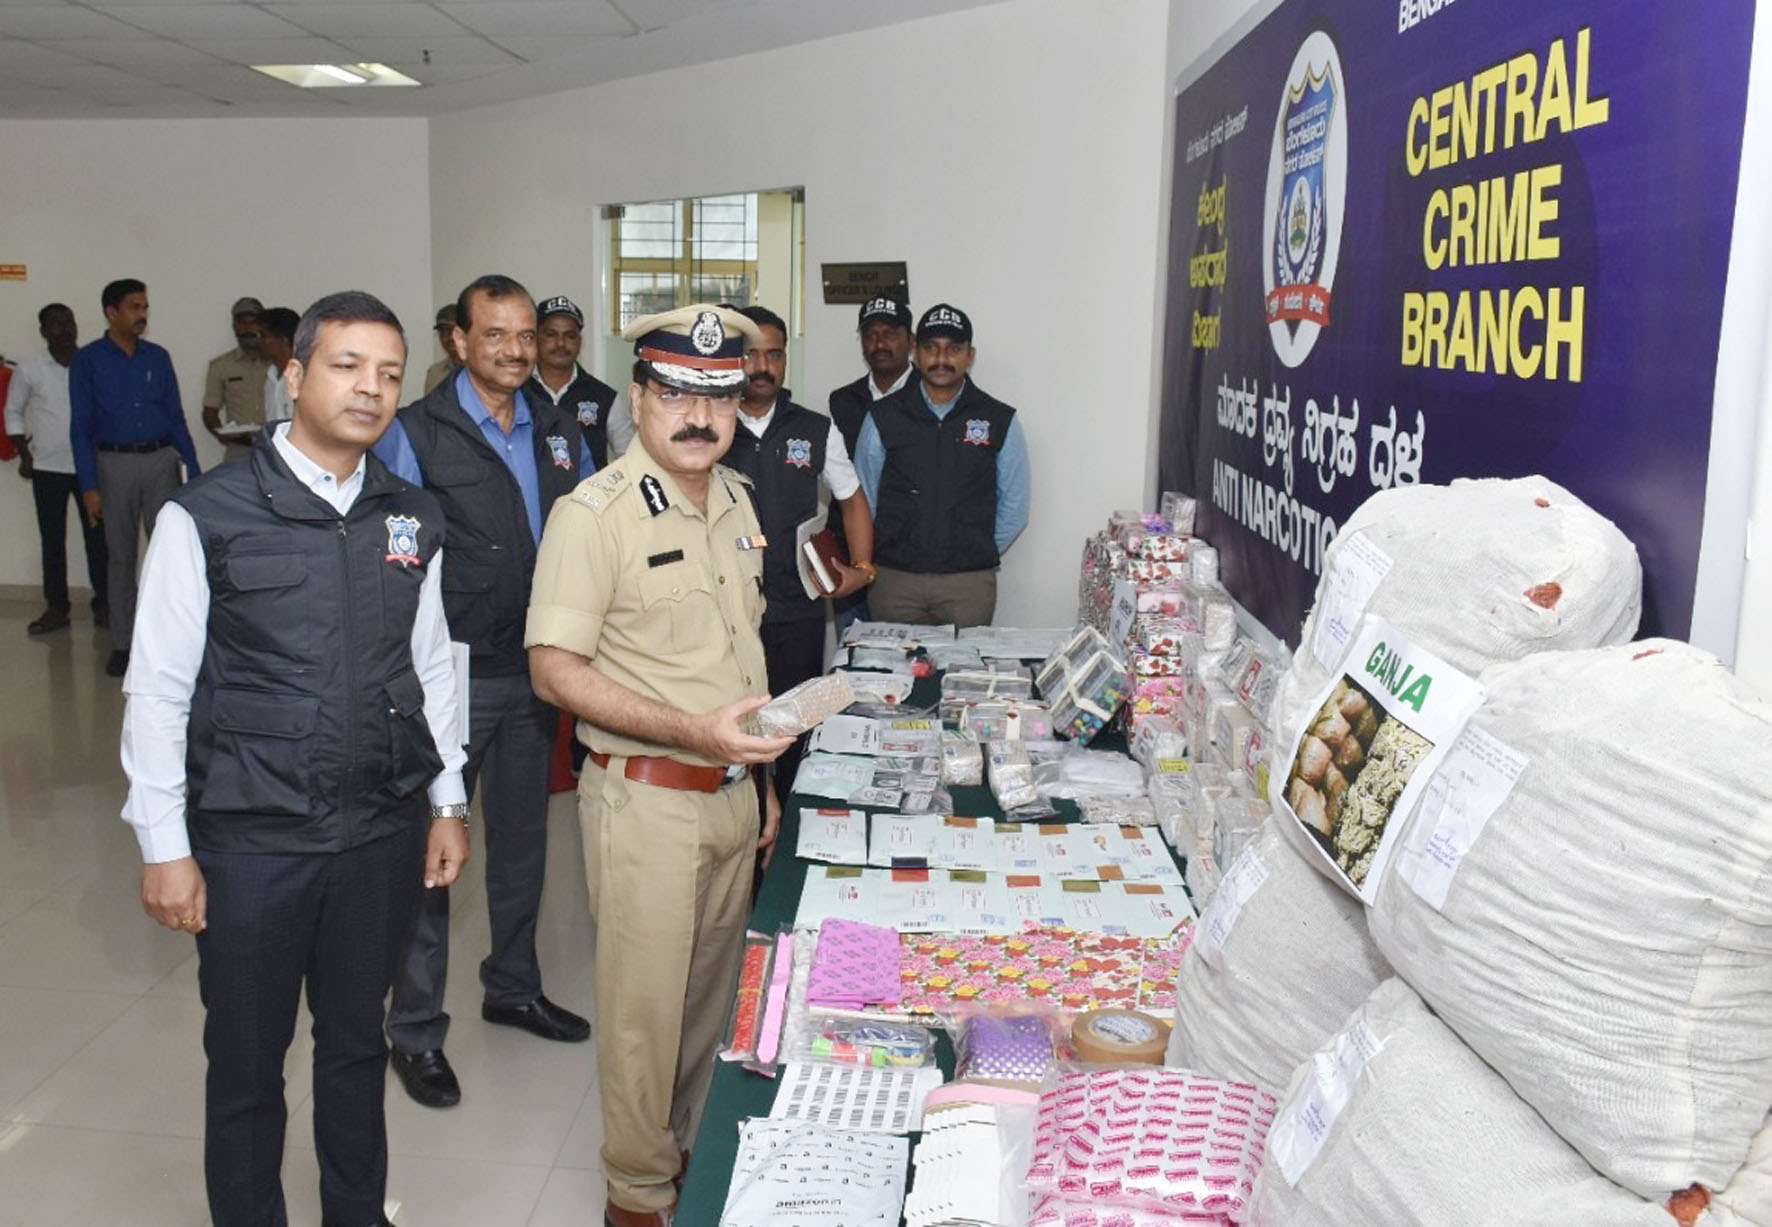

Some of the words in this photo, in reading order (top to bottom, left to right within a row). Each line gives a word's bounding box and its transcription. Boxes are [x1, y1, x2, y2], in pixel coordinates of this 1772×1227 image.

[1405, 27, 1610, 177] CENTRAL
[1423, 163, 1562, 271] CRIME
[1401, 285, 1585, 383] BRANCH
[1217, 372, 1258, 438] ಮಾದಕ
[1302, 394, 1360, 494] ನಿಗ್ರಹ
[1369, 404, 1426, 490] ದಳ
[1212, 457, 1239, 521] ANTI
[1365, 641, 1433, 713] GANJA
